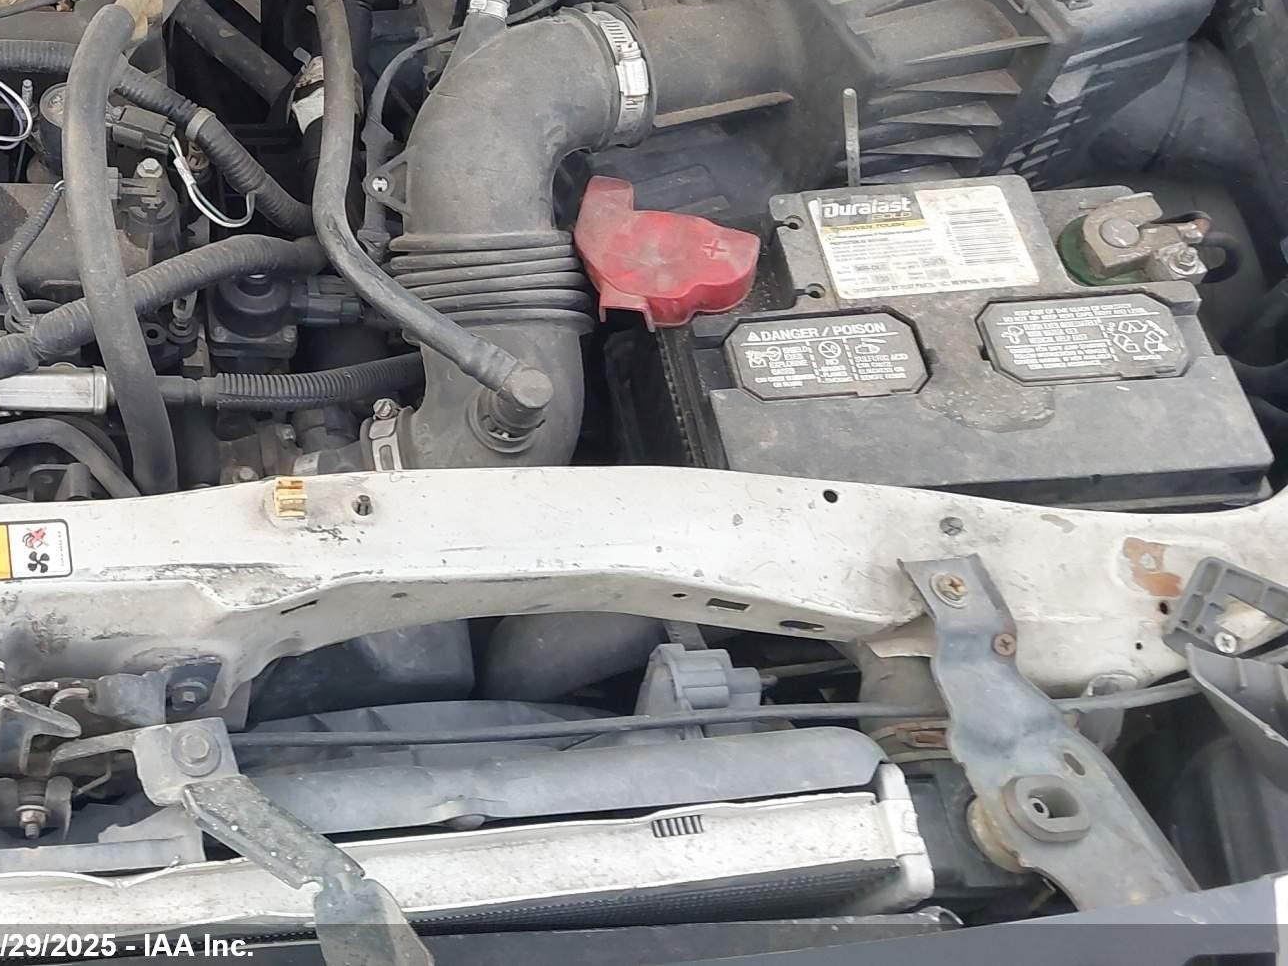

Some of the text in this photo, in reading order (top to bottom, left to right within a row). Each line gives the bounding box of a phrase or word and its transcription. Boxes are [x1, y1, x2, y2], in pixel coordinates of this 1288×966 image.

[822, 196, 913, 219] Duralast
[871, 211, 913, 220] GOLD
[759, 328, 818, 341] DANGER
[833, 321, 887, 335] POISON
